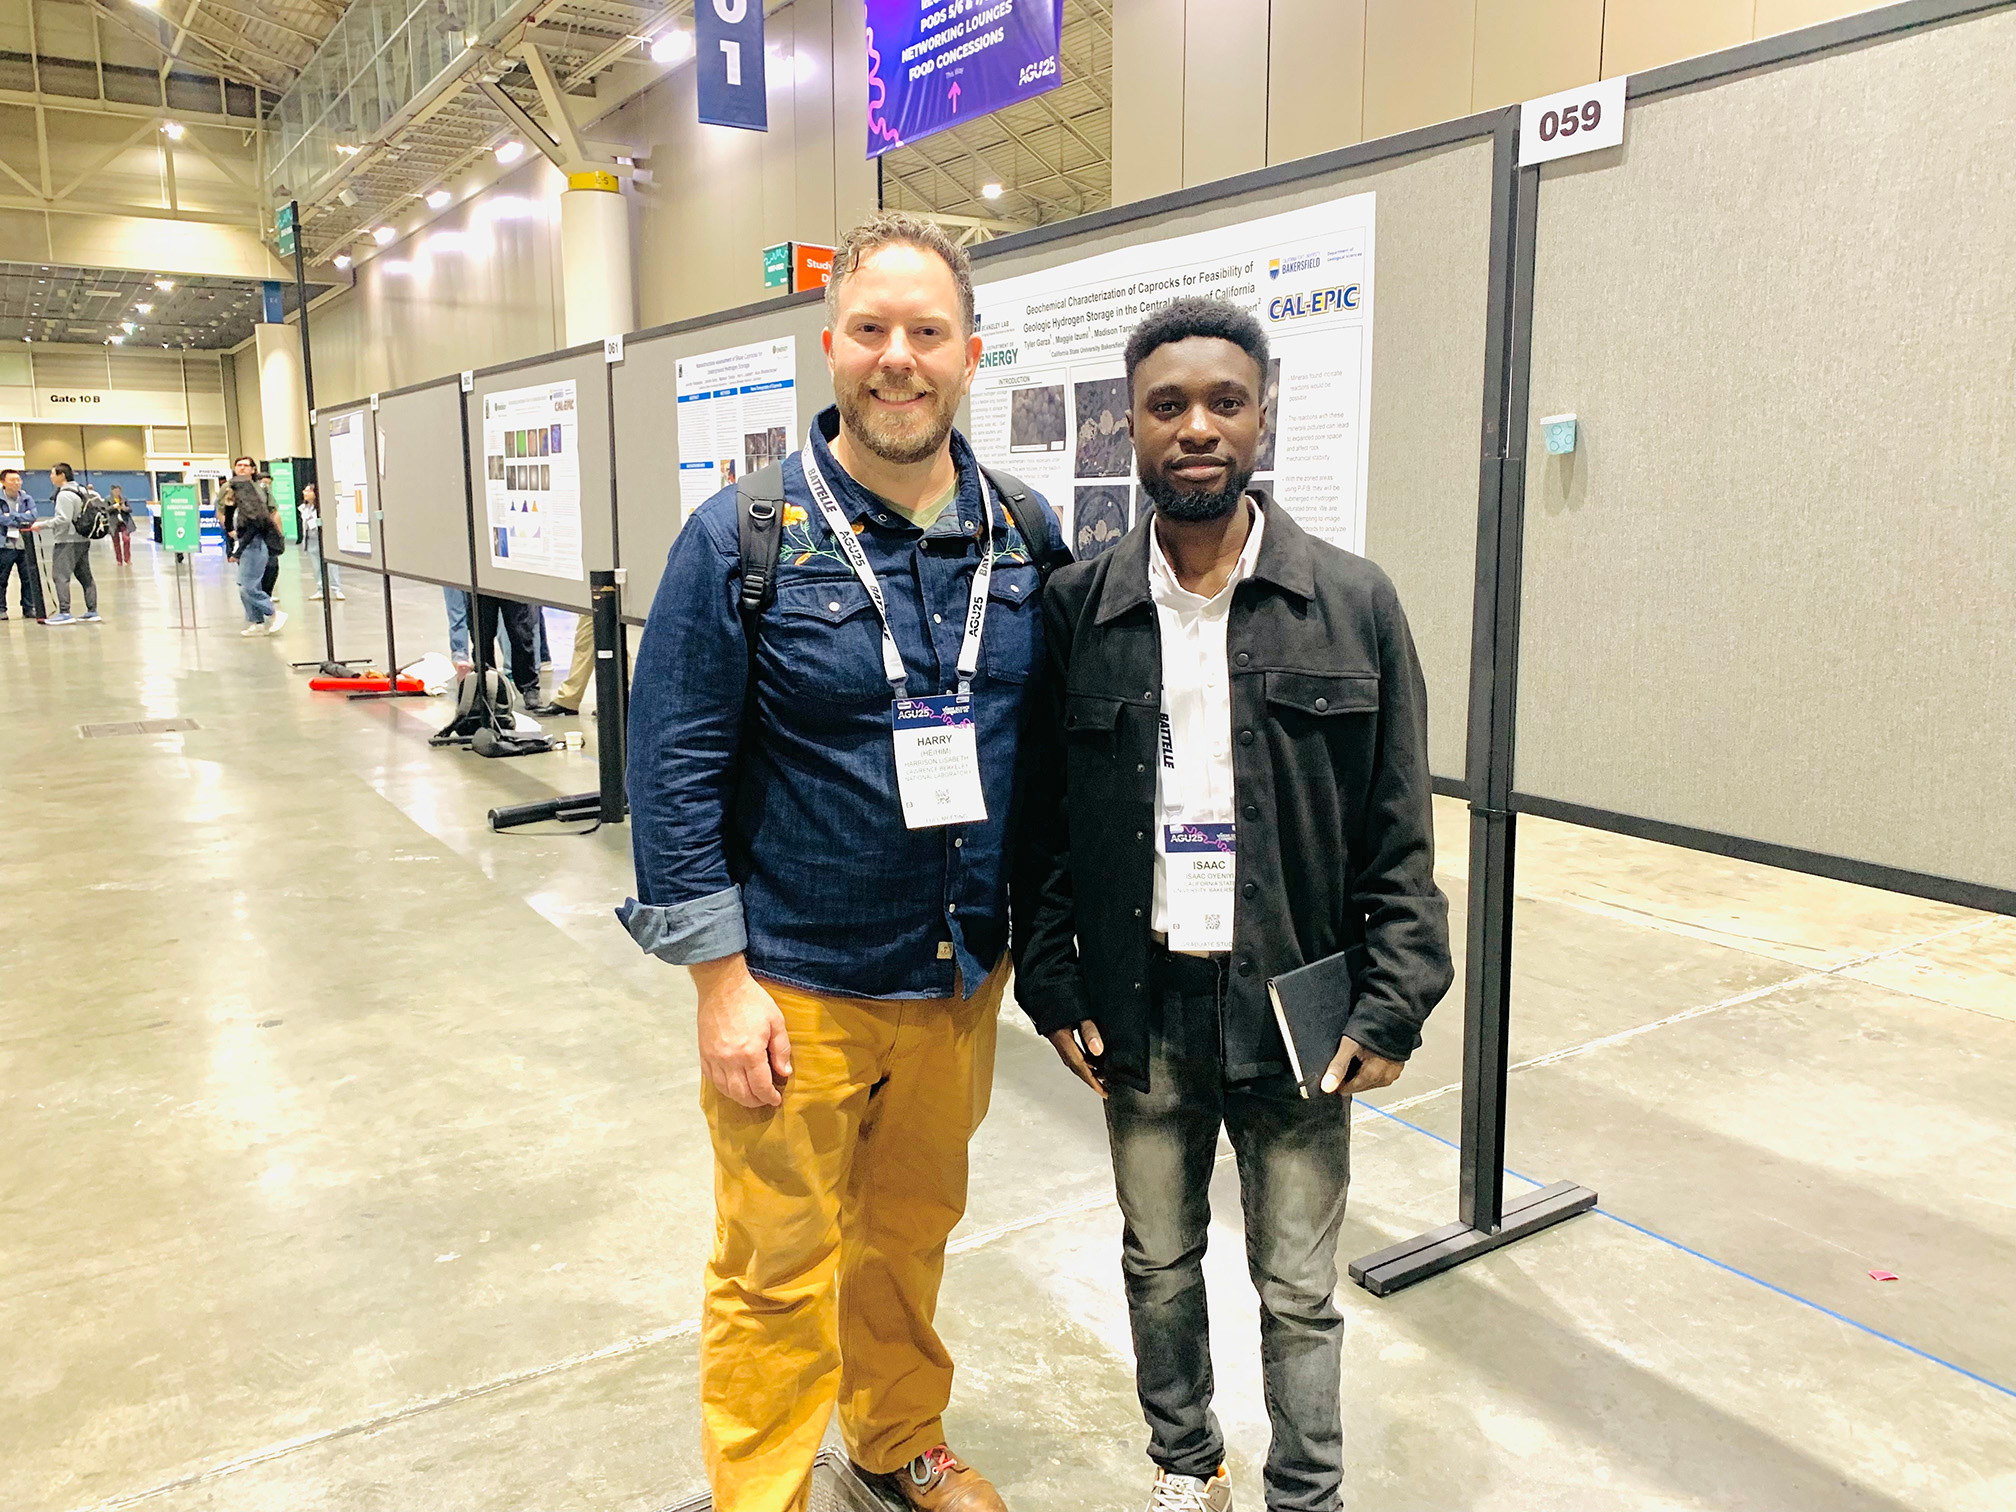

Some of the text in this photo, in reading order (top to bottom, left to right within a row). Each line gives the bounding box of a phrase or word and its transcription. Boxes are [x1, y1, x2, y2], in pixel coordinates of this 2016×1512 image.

[920, 7, 947, 33] PODS
[948, 0, 964, 19] 5/6
[901, 0, 1013, 63] NETWORKING LOUNGES
[908, 26, 1004, 82] FOOD CONCESSIONS
[1018, 56, 1056, 86] AGU25
[1539, 100, 1602, 142] 059
[807, 258, 832, 273] Study
[1282, 257, 1320, 275] BAKERSFIELD
[1026, 261, 1254, 315] Geochemical Characterization of Caprocks for Feasibility of
[1023, 319, 1051, 333] Geologic
[1052, 315, 1084, 330] Hydrogen
[1086, 309, 1114, 322] Storage
[1116, 306, 1123, 316] in
[1125, 304, 1137, 315] the
[1140, 297, 1170, 312] Central
[1215, 282, 1255, 300] California
[1269, 285, 1360, 321] CAL-EPIC
[1001, 320, 1009, 328] LAB
[607, 342, 619, 355] 061
[1024, 340, 1035, 350] Tyler
[1055, 335, 1073, 345] Maggie
[1094, 327, 1118, 337] Madison
[979, 348, 1018, 369] ENERGY
[998, 375, 1031, 385] INTRODUCTION
[50, 394, 101, 403] Gate 10 B
[807, 468, 837, 514] BATTELLE
[839, 529, 866, 568] AGU25
[968, 596, 984, 638] AGU25
[898, 709, 930, 720] AGU25
[917, 734, 953, 747] HARRY
[1159, 712, 1175, 769] BATTELLE
[904, 759, 938, 767] HARRISON
[1170, 834, 1204, 842] AGU25
[1193, 860, 1226, 870] ISAAC
